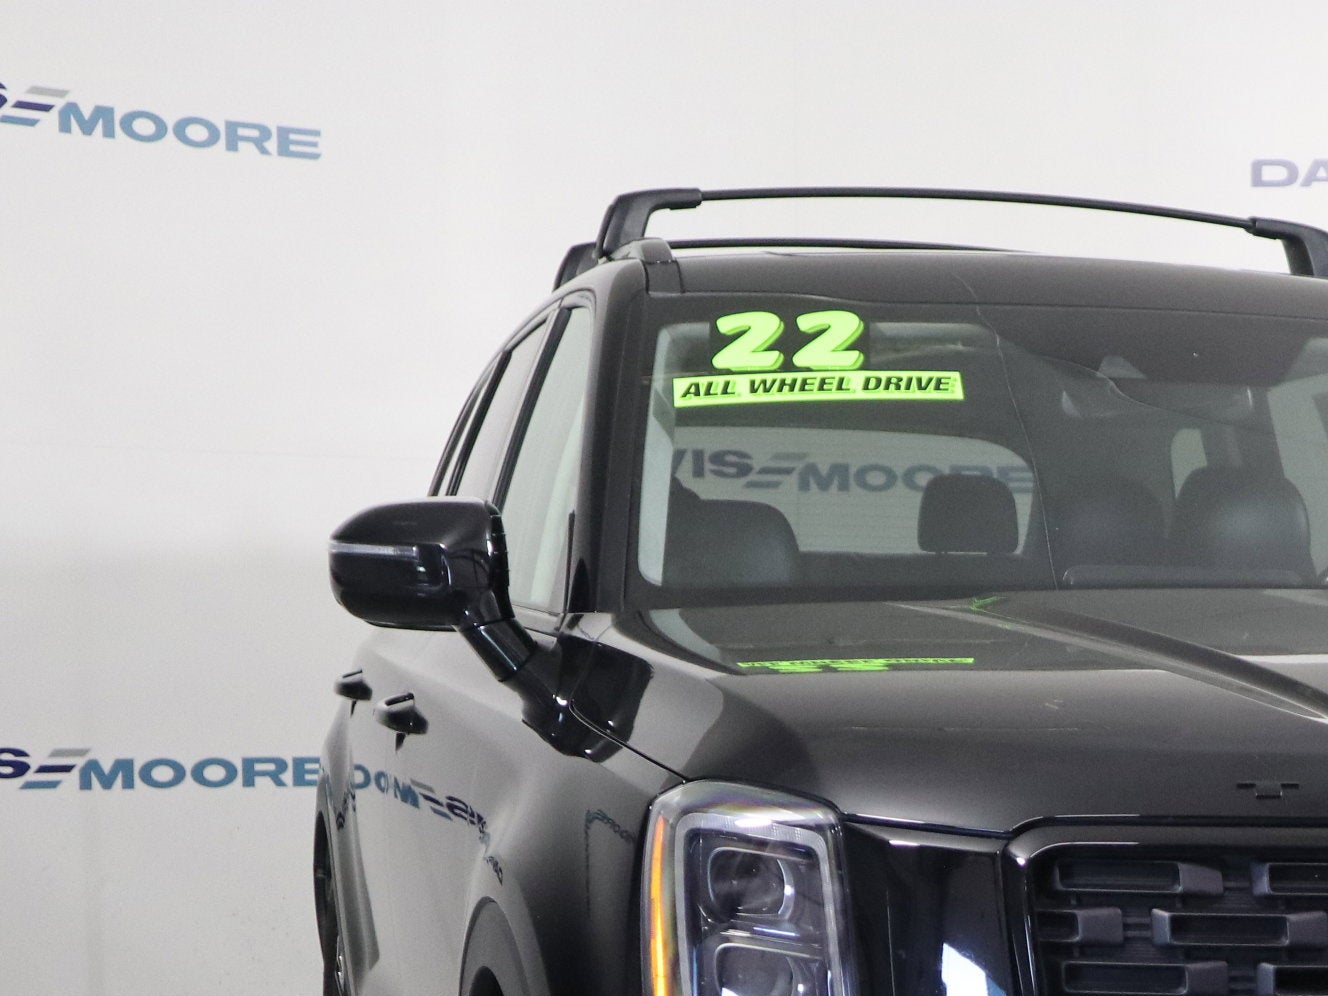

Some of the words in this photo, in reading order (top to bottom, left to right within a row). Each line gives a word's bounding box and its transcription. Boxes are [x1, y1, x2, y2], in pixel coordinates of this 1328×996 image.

[58, 101, 322, 160] MOORE
[711, 310, 865, 371] 22
[680, 380, 738, 399] ALL
[749, 376, 853, 395] WHEEL
[861, 375, 955, 393] DRIVE
[79, 756, 320, 790] MOORE
